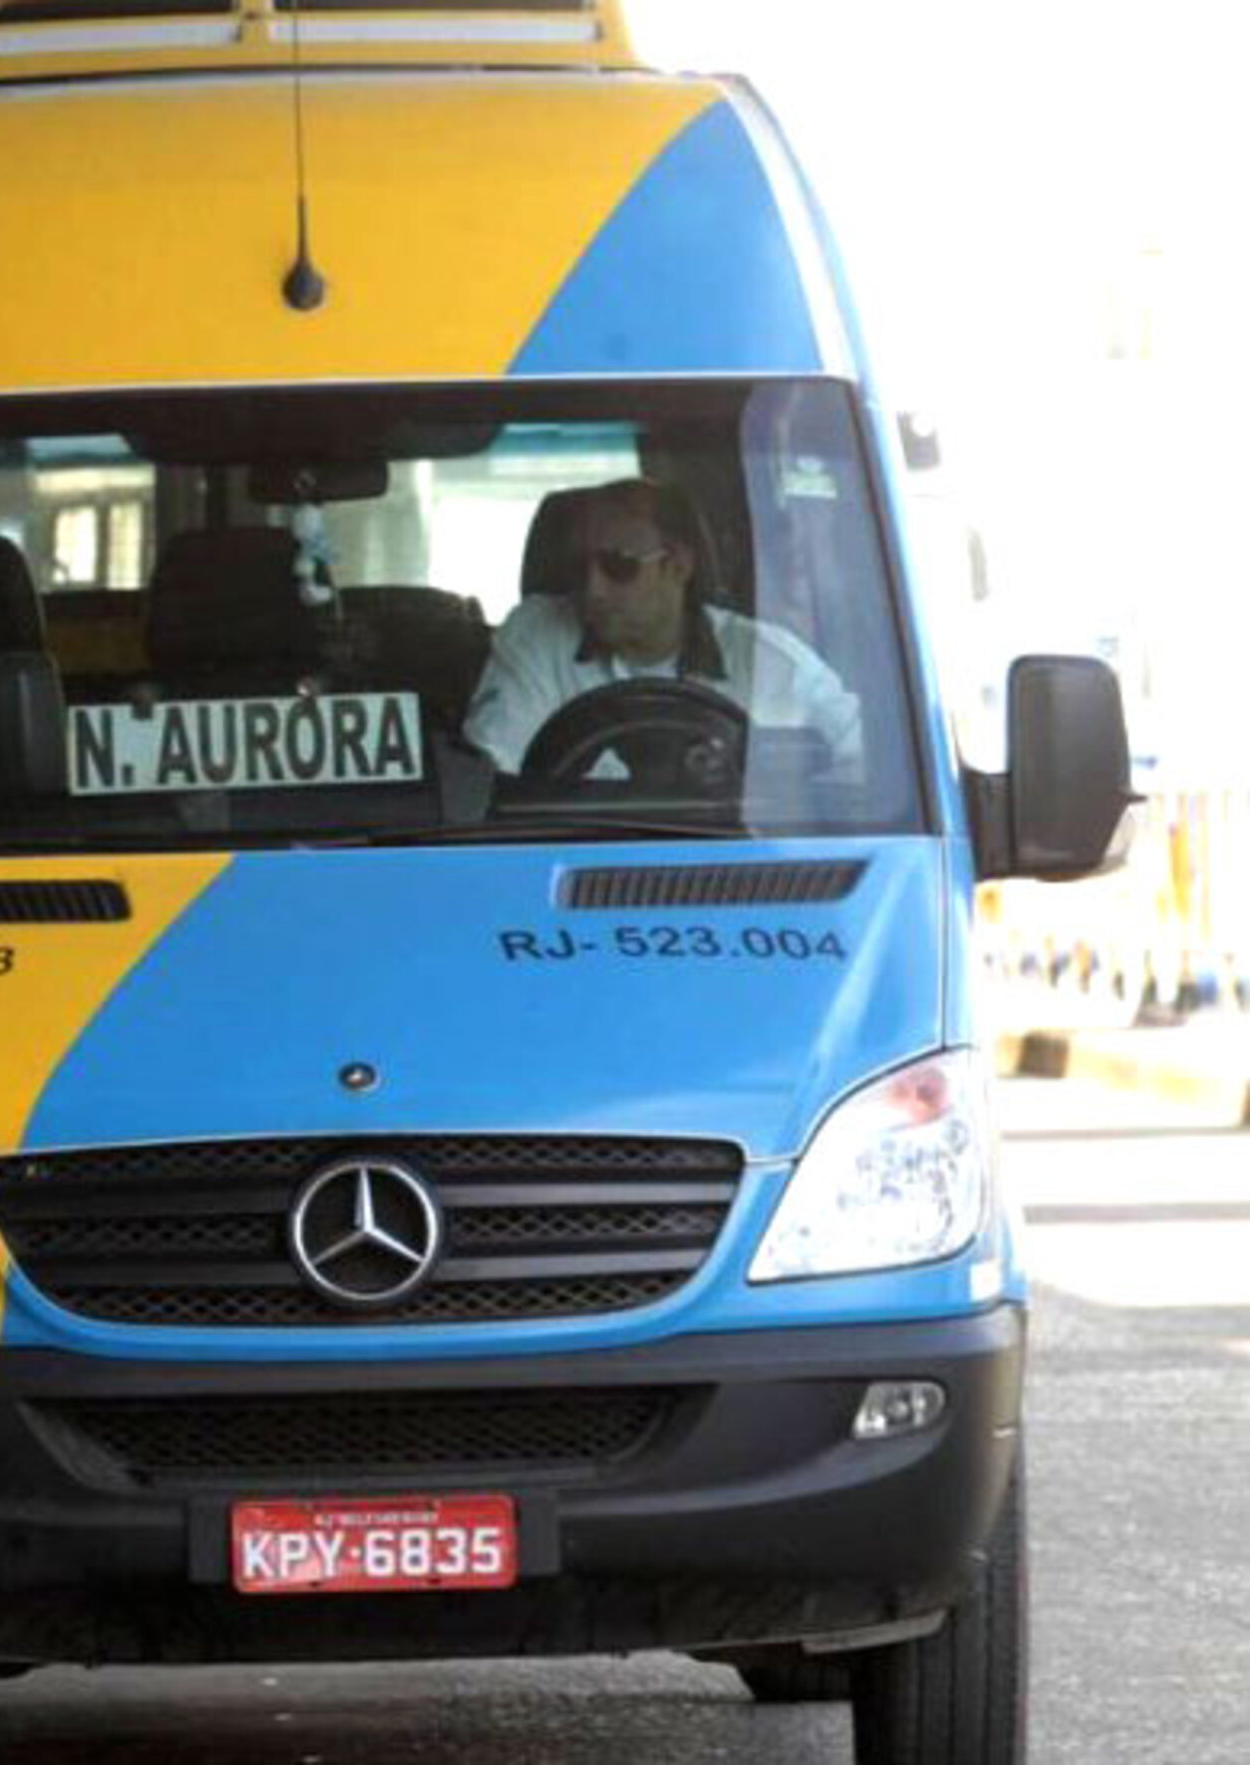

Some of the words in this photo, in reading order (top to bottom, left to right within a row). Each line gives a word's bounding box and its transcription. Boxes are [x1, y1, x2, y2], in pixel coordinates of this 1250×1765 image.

[75, 709, 134, 788] N.
[156, 697, 416, 786] AURORA
[498, 929, 597, 961] RJ-
[613, 926, 847, 960] 523.004
